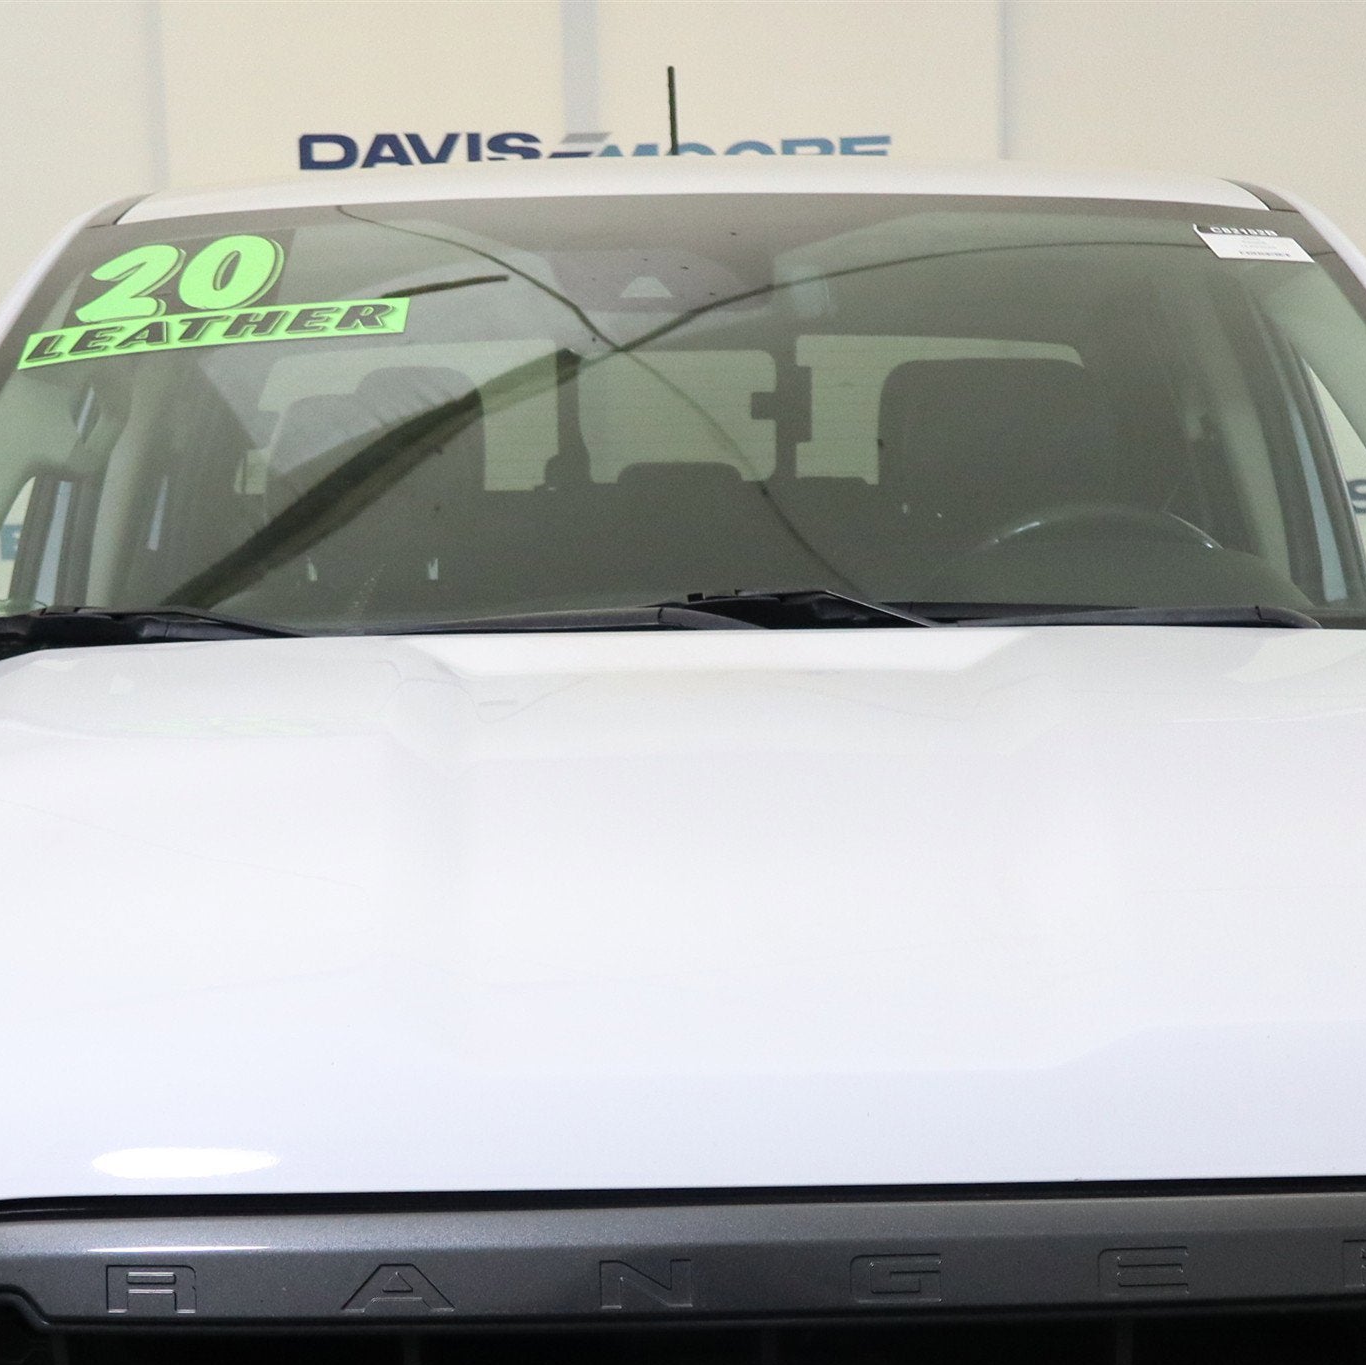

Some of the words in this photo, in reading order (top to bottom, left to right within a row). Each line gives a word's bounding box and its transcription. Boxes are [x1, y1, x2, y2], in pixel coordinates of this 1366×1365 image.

[299, 132, 542, 171] DAVIS
[75, 233, 285, 324] 20
[25, 302, 397, 363] LEATHER
